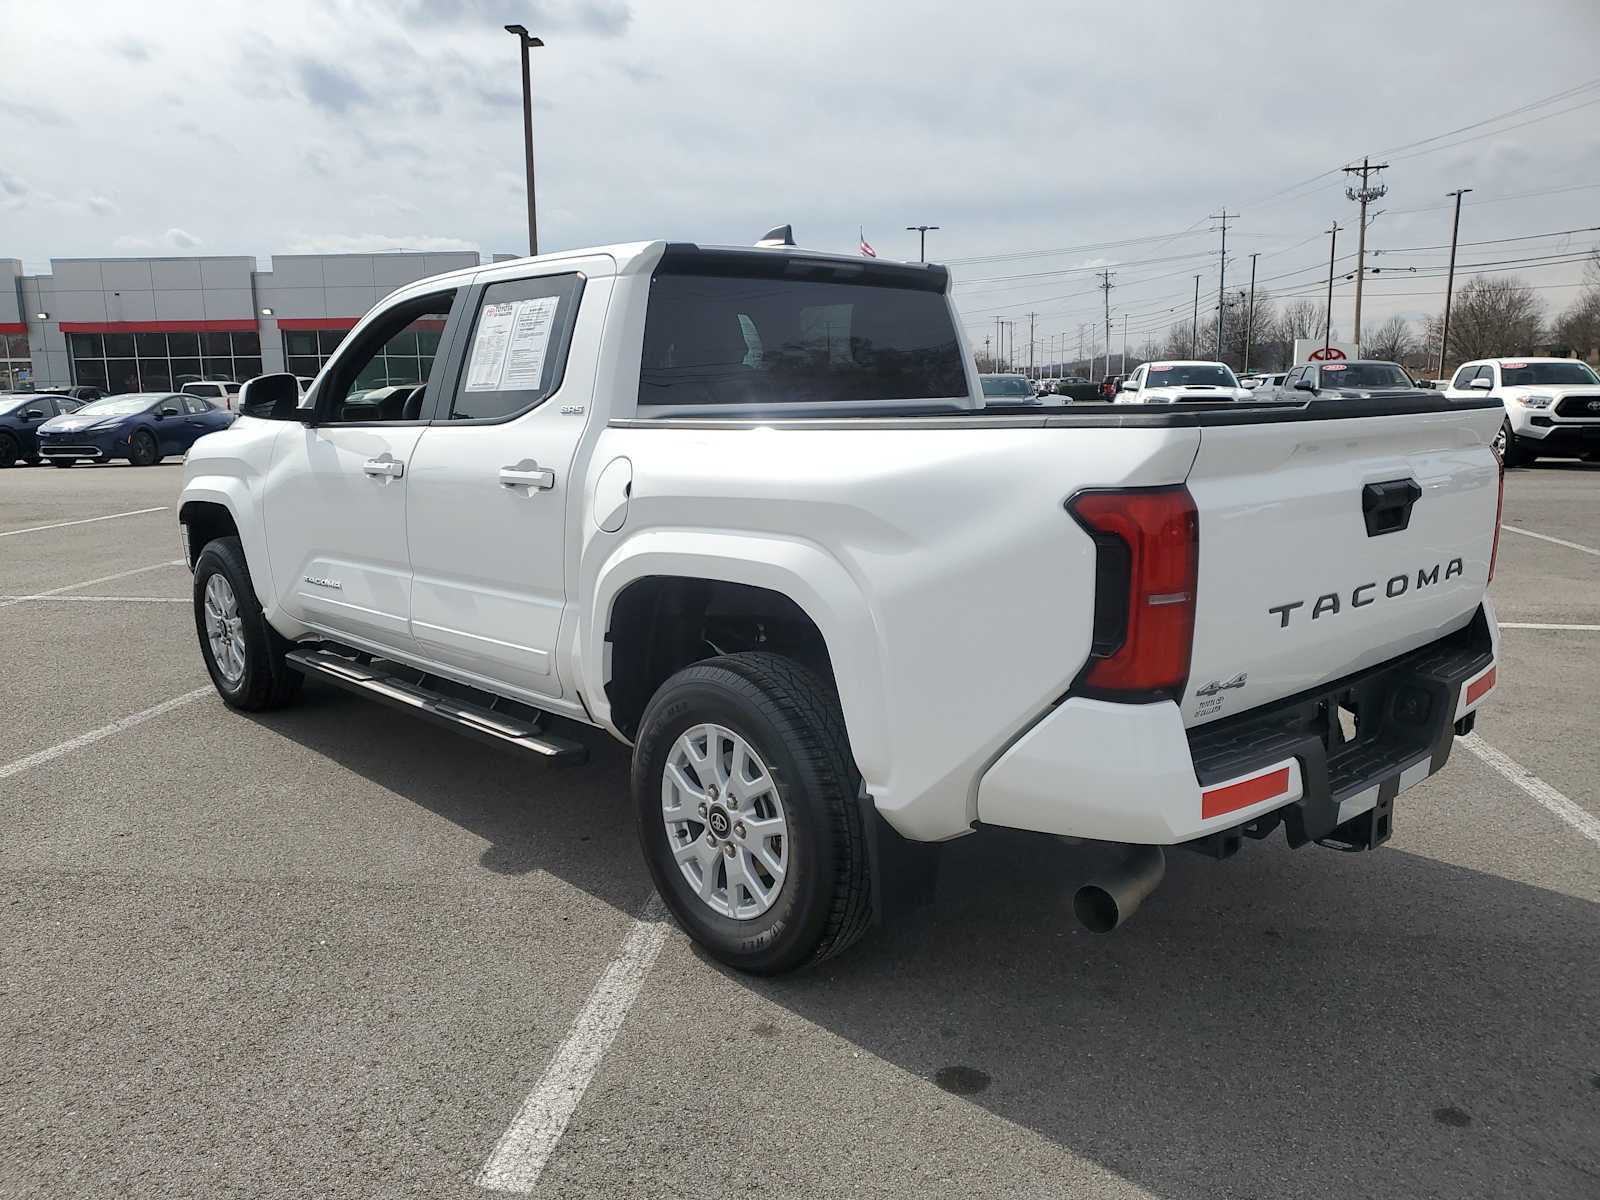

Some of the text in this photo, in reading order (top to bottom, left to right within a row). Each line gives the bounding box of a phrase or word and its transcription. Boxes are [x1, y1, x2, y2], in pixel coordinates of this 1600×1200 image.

[560, 404, 585, 415] SR5
[303, 575, 343, 590] TACOMA
[1268, 557, 1464, 628] TACOMA
